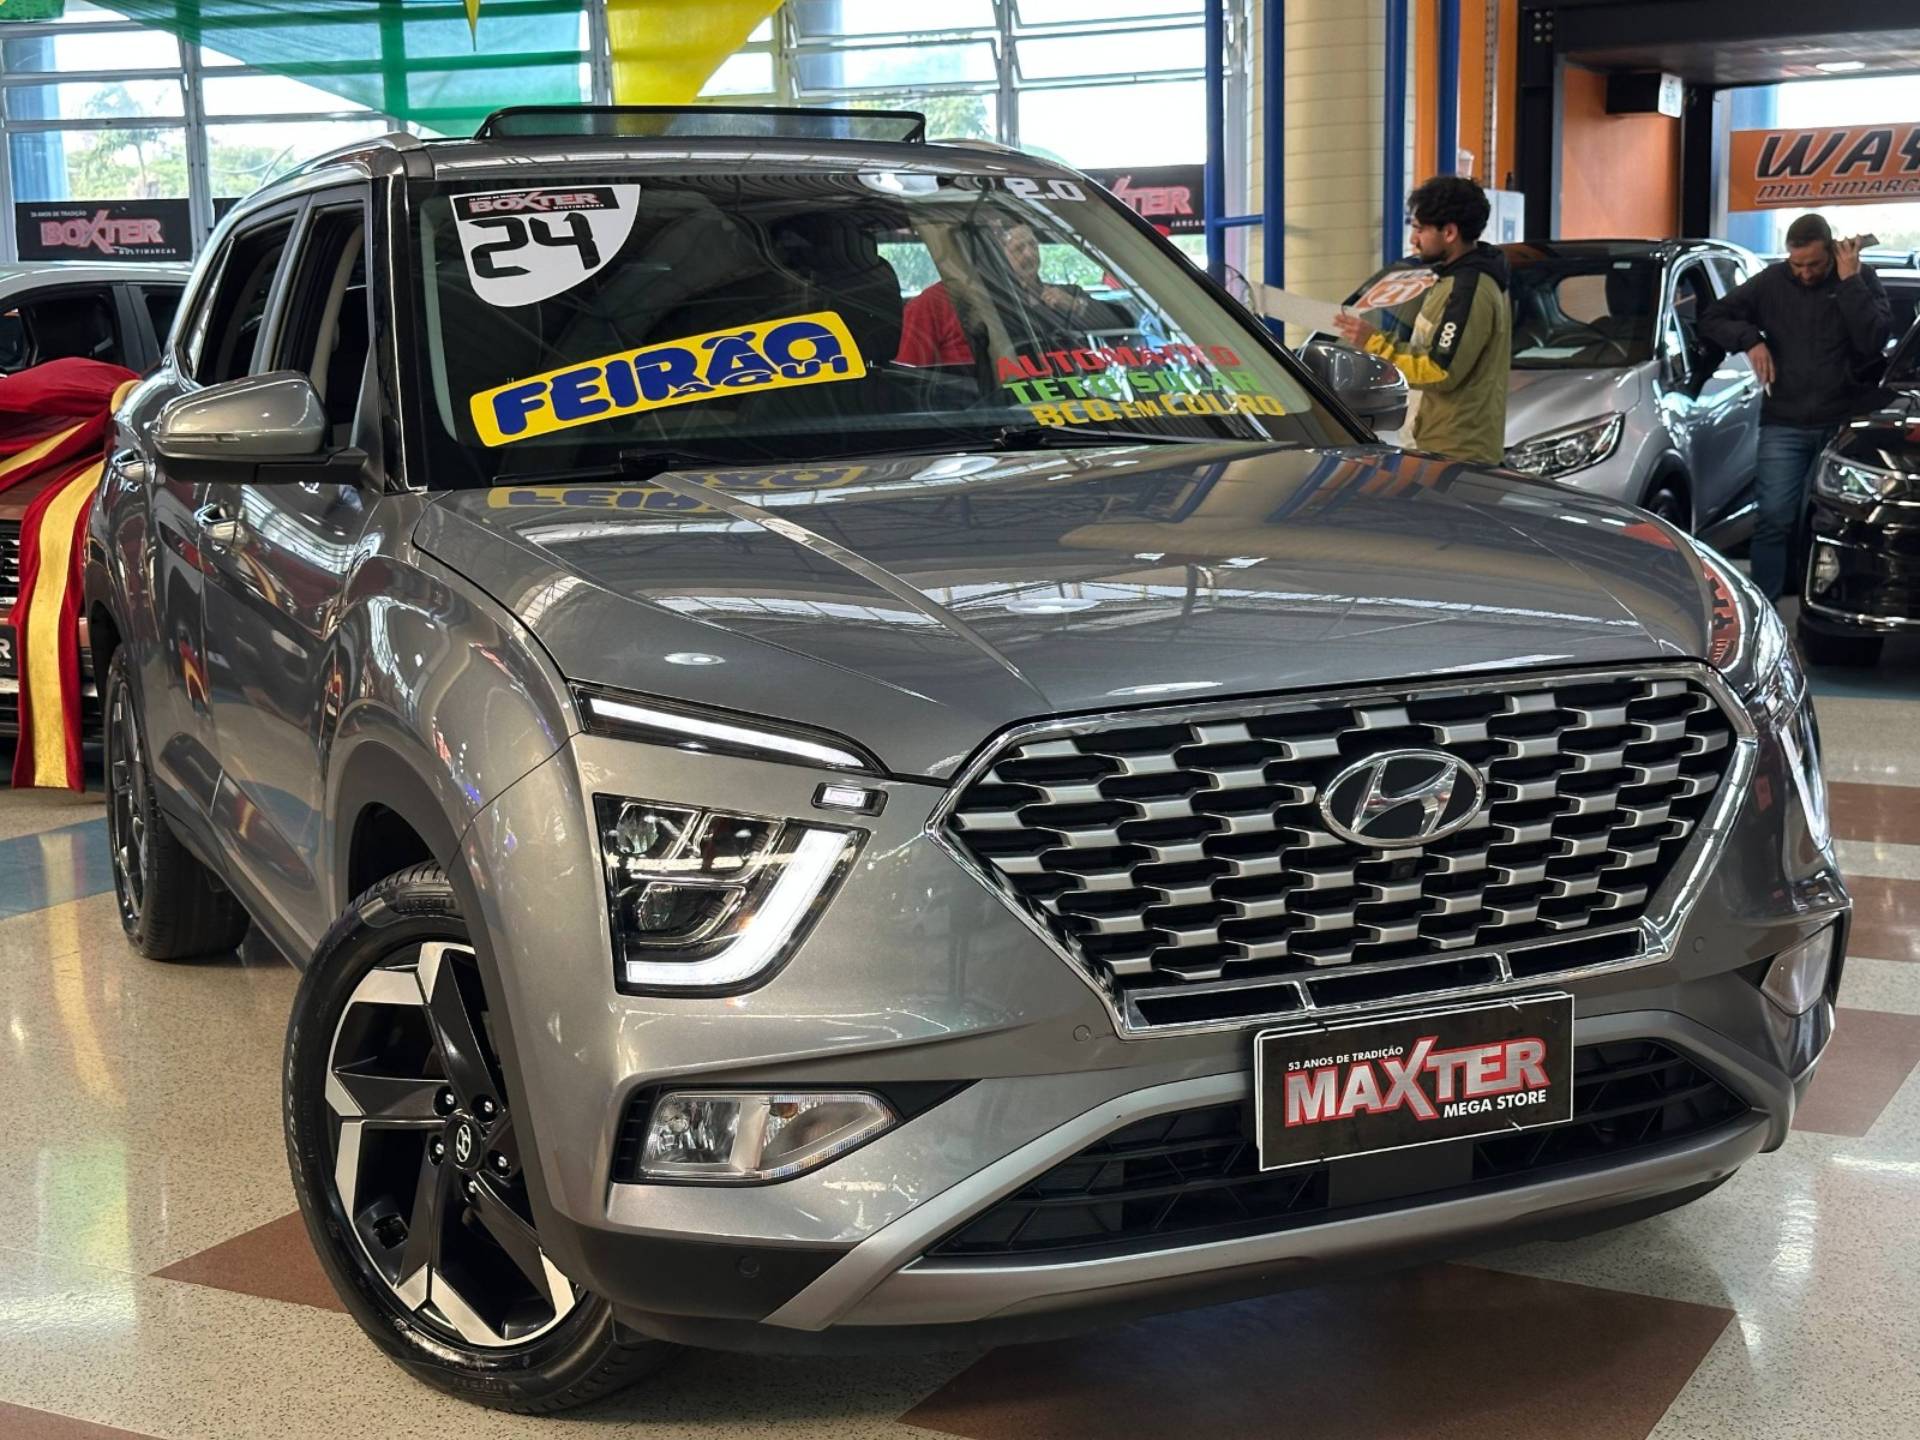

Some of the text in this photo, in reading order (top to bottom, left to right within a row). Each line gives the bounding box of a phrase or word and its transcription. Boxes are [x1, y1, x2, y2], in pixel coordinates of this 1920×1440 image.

[468, 191, 600, 213] BOXTER
[1004, 177, 1086, 201] 2.0
[40, 209, 164, 254] BOXTER
[468, 212, 602, 279] 24
[493, 322, 842, 435] FEIRÃO
[1002, 374, 1122, 405] TETO
[1288, 1045, 1404, 1071] 53 ANOS DE TRADIÇÃO
[1284, 1035, 1551, 1128] MAXTER
[1443, 1089, 1547, 1119] MEGA STORE
